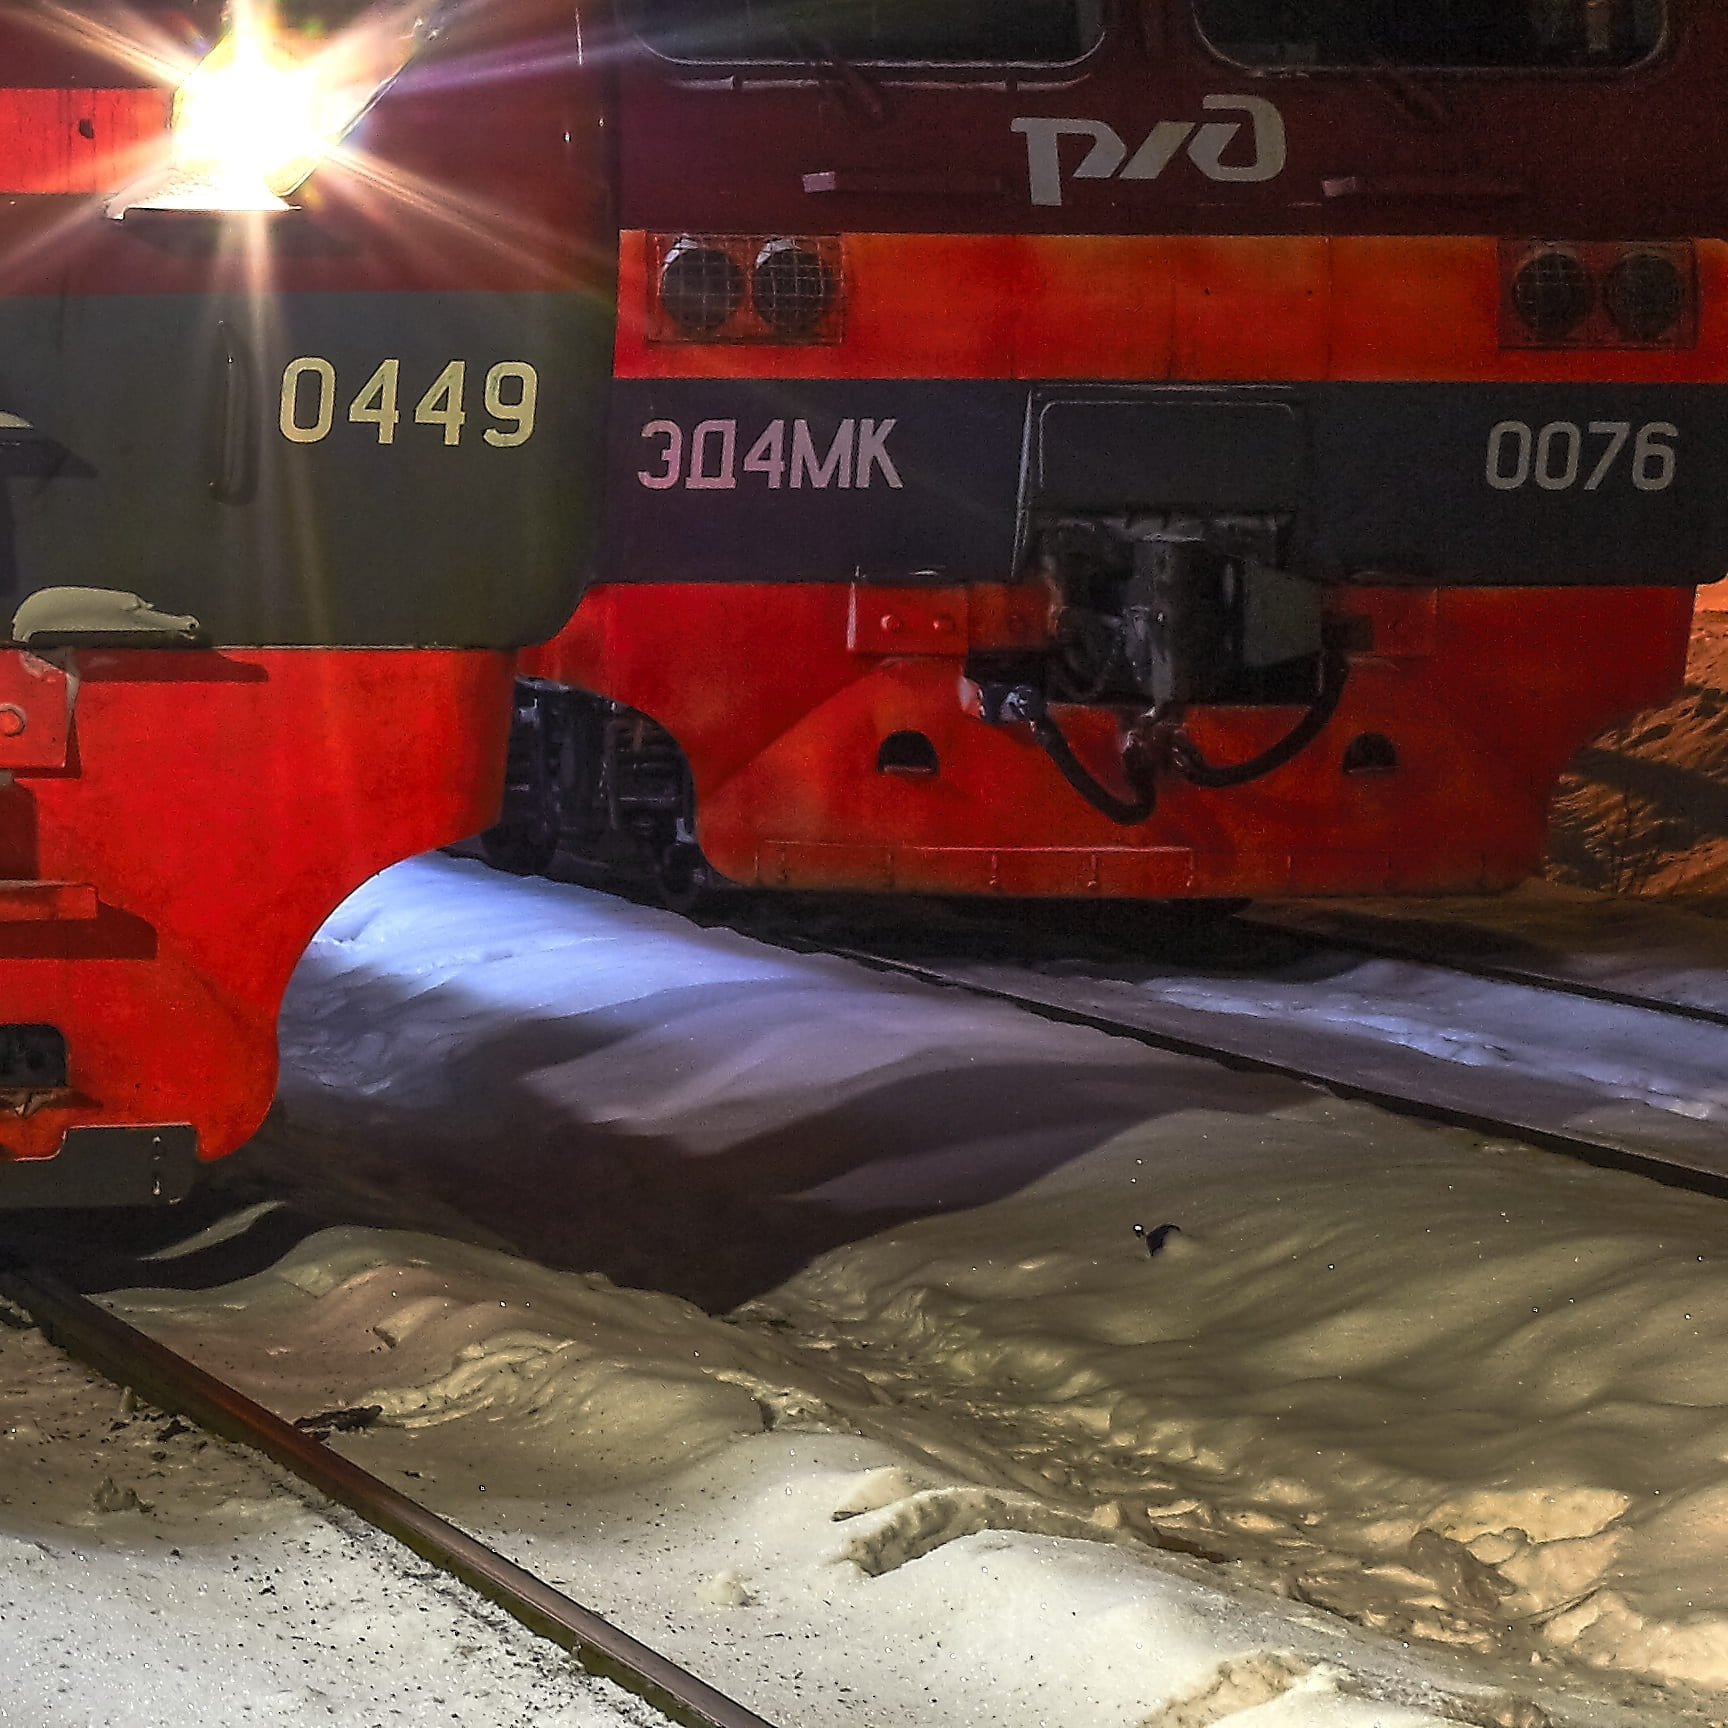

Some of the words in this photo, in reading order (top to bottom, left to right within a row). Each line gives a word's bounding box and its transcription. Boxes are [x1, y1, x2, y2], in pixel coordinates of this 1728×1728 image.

[279, 356, 539, 447] 0449
[638, 418, 904, 489] ЭД4МК
[1485, 421, 1680, 490] 0076
